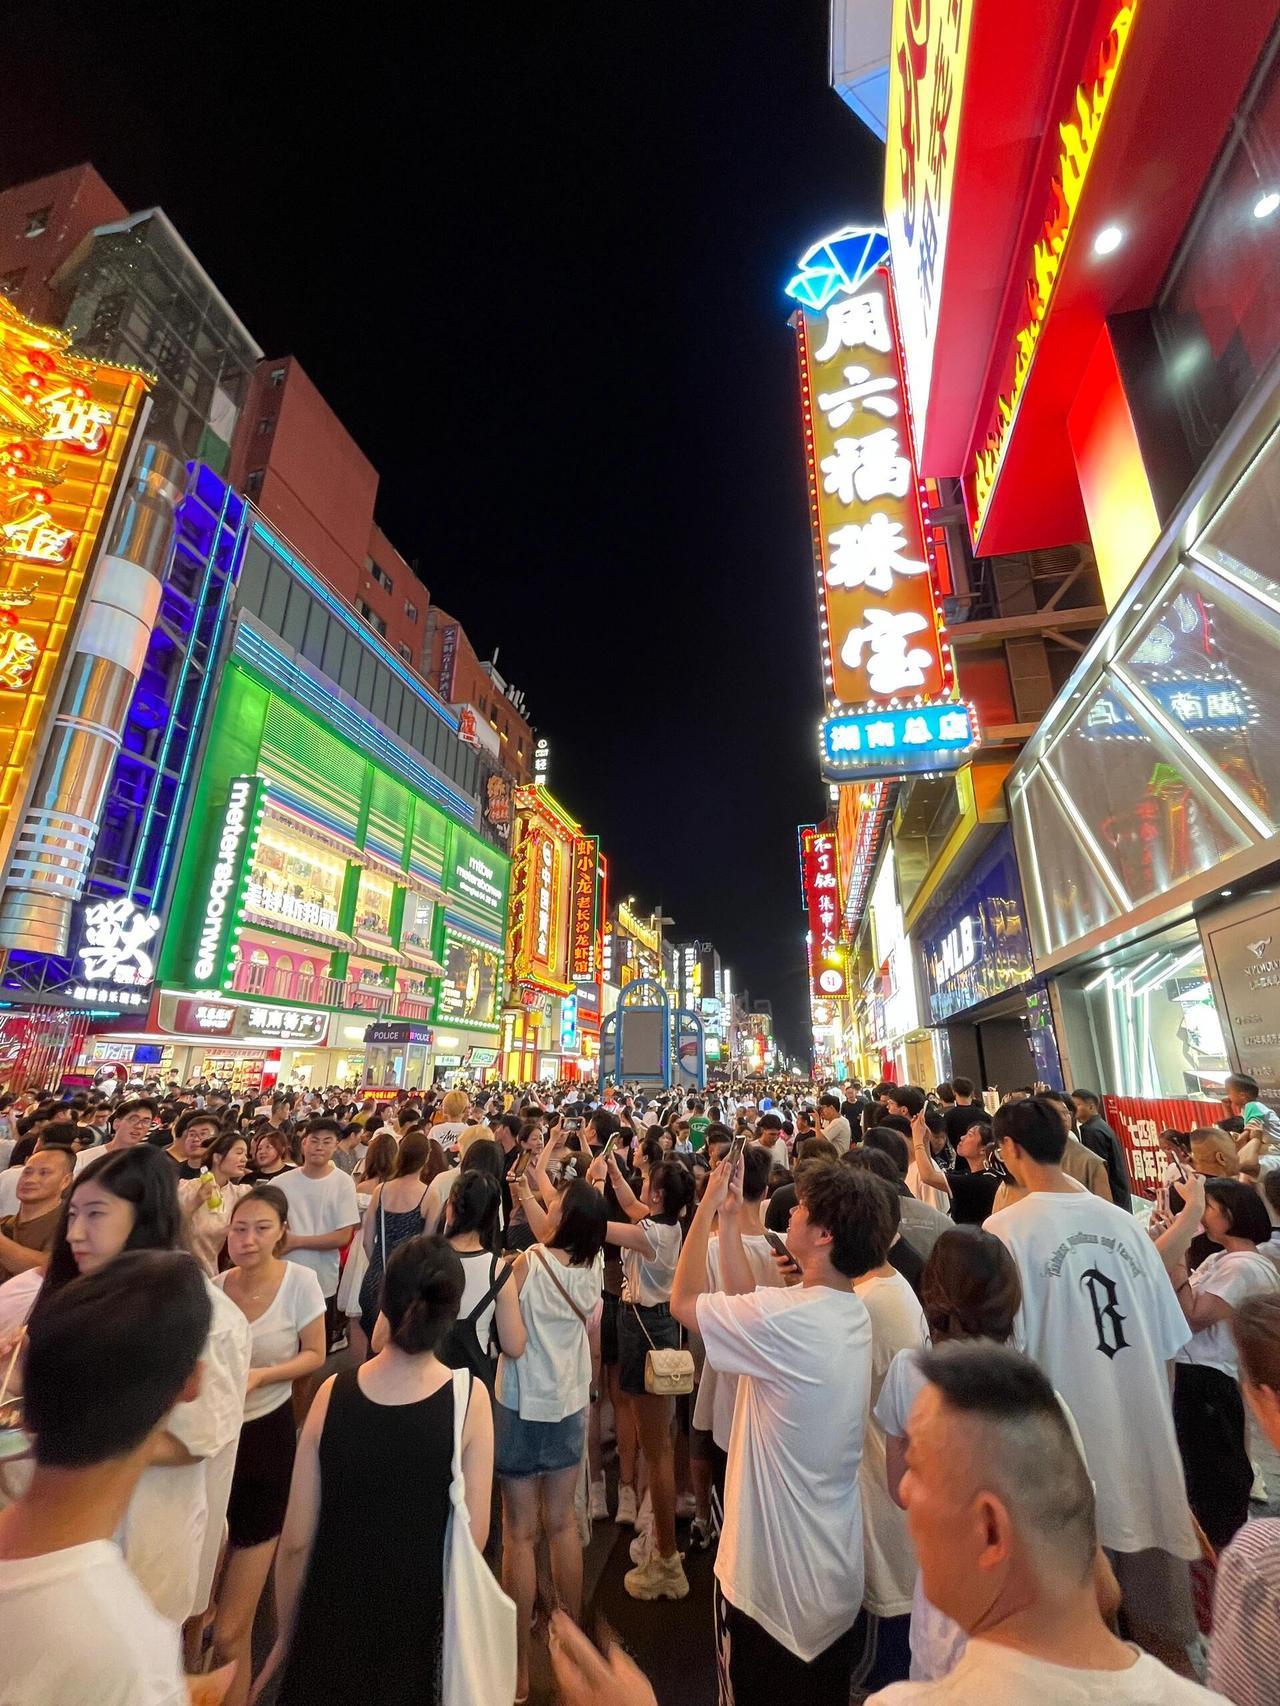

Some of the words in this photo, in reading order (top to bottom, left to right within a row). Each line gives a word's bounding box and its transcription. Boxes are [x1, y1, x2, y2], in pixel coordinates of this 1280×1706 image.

[815, 288, 931, 694] 周六福珠宝
[830, 723, 971, 752] 湖南总店
[194, 781, 250, 980] metersbonwe
[818, 894, 838, 961] 集市火锅
[941, 915, 975, 980] MLB
[374, 1031, 399, 1040] POLICE
[414, 1033, 430, 1041] POLICE
